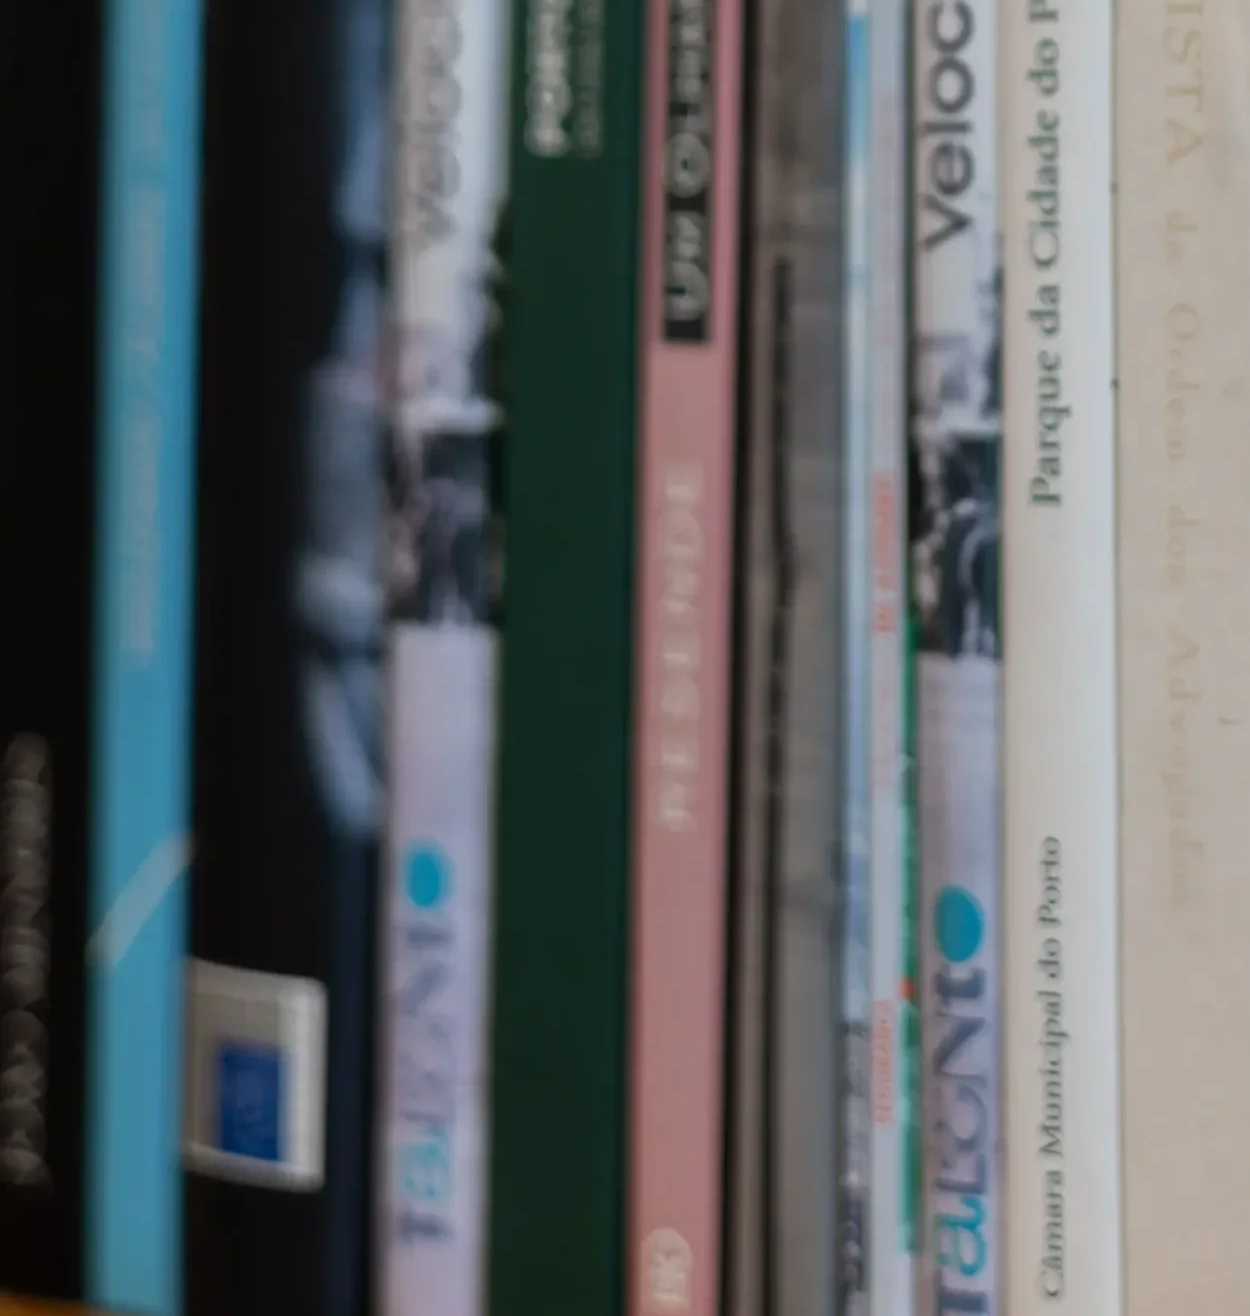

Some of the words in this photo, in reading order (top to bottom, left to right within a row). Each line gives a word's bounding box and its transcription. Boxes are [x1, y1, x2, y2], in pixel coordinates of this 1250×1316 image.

[1026, 36, 1062, 98] do
[1026, 110, 1062, 272] Cidade
[1027, 282, 1062, 340] da
[1028, 350, 1072, 508] Parque
[1038, 834, 1064, 929] Porto
[1038, 934, 1064, 982] do
[1035, 988, 1070, 1158] Municipal
[1036, 1168, 1066, 1301] Câmara
